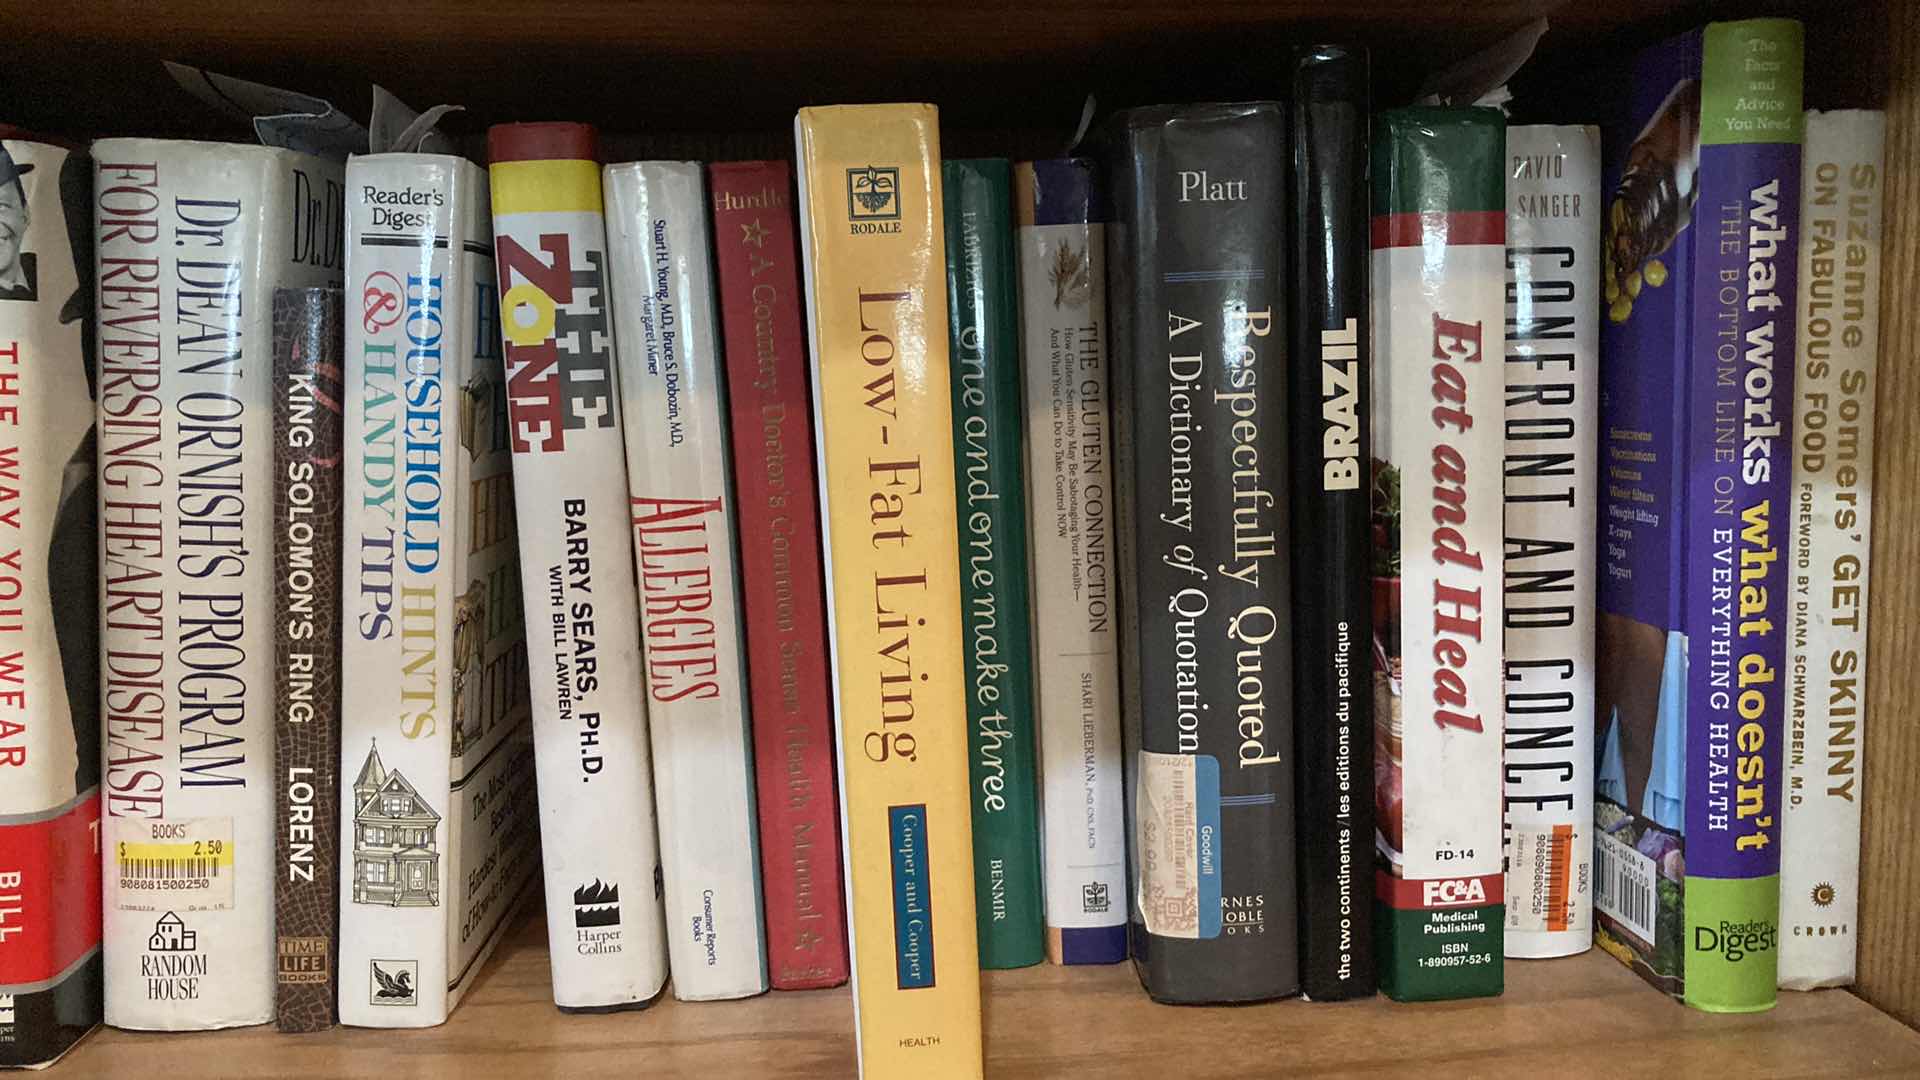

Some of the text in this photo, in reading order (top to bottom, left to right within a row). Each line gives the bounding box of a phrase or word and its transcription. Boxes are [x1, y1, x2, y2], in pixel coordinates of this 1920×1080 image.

[1726, 118, 1752, 130] You
[363, 186, 444, 206] Reader's
[1178, 171, 1248, 202] Platt
[1518, 194, 1580, 217] SANGER
[654, 220, 666, 250] Stuart
[850, 222, 902, 234] RODALE
[497, 234, 573, 454] ZONE
[557, 250, 615, 430] THE
[641, 296, 659, 376] Margaret Miner
[753, 285, 778, 392] Country
[1168, 312, 1203, 340] A
[1802, 162, 1839, 474] ON FABULOUS FOOD
[662, 332, 675, 360] Bruce
[666, 373, 680, 420] Dobozin,
[1322, 318, 1360, 492] BRAZIL
[358, 272, 405, 642] & HANDY TIPS
[1050, 328, 1067, 538] And What You Can Do to Take Control NOW
[1064, 328, 1081, 557] How Gluten Sensitivity May Be Sabotaging Your
[1160, 352, 1203, 532] Dictionary
[1506, 246, 1576, 626] CONFRONT AND
[965, 416, 1000, 506] and
[1080, 322, 1108, 633] THE GLUTEN CONNECTION
[1826, 162, 1878, 804] Suzanne Somers' GET SKINNY
[99, 160, 164, 818] FOR REVERSING HEART DISEASE
[175, 196, 250, 788] Dr. DEAN ORNISH'S PROGRAM
[401, 273, 442, 740] HOUSEHOLD HINTS
[1608, 504, 1659, 527] Weight lifting
[1708, 201, 1744, 832] THE BOTTOM LINE ON EVERYTHING HEALTH
[1736, 180, 1786, 850] what works what doesn't
[289, 374, 314, 722] KING SOLOMON'S RING
[968, 510, 993, 588] one
[1215, 306, 1280, 768] Respectfully Quoted
[1431, 312, 1484, 734] Eat and Heal
[1608, 524, 1632, 540] X-rays
[1163, 545, 1208, 580] of
[1608, 544, 1626, 560] Yoga
[1608, 562, 1632, 580] Yogurt
[630, 496, 723, 702] ALLERGIES
[549, 565, 572, 720] WITH BILL LAWREN
[564, 498, 604, 783] BARRY SEARS, PH.D.
[864, 568, 929, 764] Living
[973, 592, 1008, 705] make
[1335, 622, 1351, 696] pacifique
[1789, 484, 1813, 811] FOREWORD BY DIANA SCHWARZBEIN, M.D.
[1081, 673, 1094, 709] SHARI
[1336, 702, 1350, 720] du
[980, 709, 1013, 812] three
[1336, 726, 1350, 791] editions
[152, 824, 186, 839] BOOKS
[290, 768, 315, 881] LORENZ
[1337, 794, 1350, 818] les
[194, 840, 222, 856] 2.50
[1201, 825, 1214, 874] Goodwill
[1338, 830, 1350, 914] continents
[1436, 849, 1474, 860] FD-14
[900, 814, 924, 980] Cooper and Cooper
[990, 860, 1006, 921] BENMIR
[1424, 878, 1486, 906] FC&A
[1578, 863, 1589, 894] BOOKS
[0, 871, 22, 944] BILL
[692, 916, 704, 942] Books
[703, 890, 717, 966] Consumer Reports
[1340, 920, 1350, 950] two
[1424, 922, 1486, 934] Publishing
[1432, 910, 1478, 922] Medical
[282, 940, 322, 954] TIME
[283, 957, 321, 970] LIFE
[577, 930, 622, 944] Harper
[578, 942, 622, 955] Collins
[1418, 954, 1491, 968] 1-890957-52-6
[1441, 942, 1468, 954] ISBN
[1695, 926, 1776, 962] Digest
[141, 954, 207, 976] RANDOM
[148, 978, 198, 1000] HOUSE
[1338, 954, 1350, 980] the
[900, 1038, 941, 1048] HEALTH
